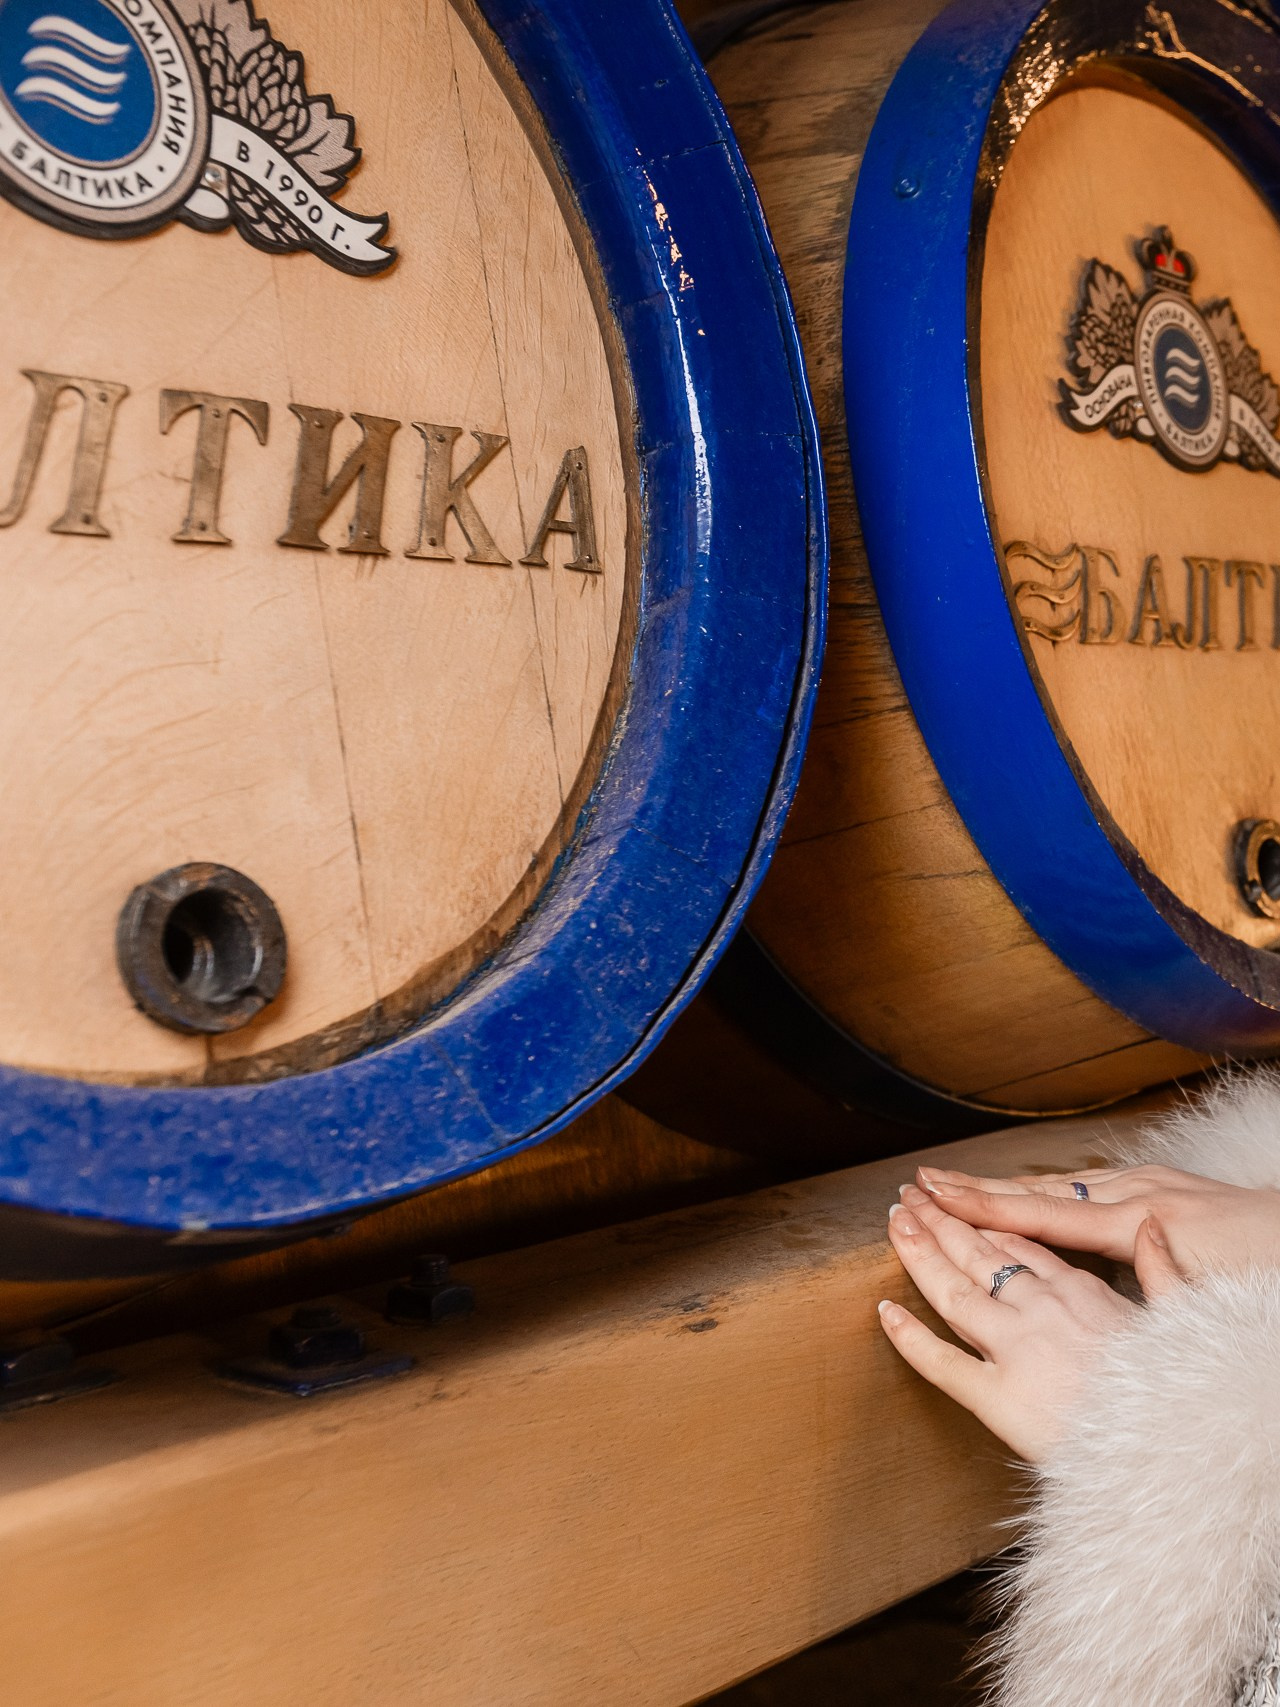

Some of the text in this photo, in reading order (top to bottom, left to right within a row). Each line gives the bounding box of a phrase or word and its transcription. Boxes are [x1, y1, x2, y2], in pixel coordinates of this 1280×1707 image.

[11, 141, 154, 200] БАЛТИКА
[237, 140, 250, 163] В
[263, 160, 324, 223] 1990
[0, 369, 603, 574] ЛТИКА
